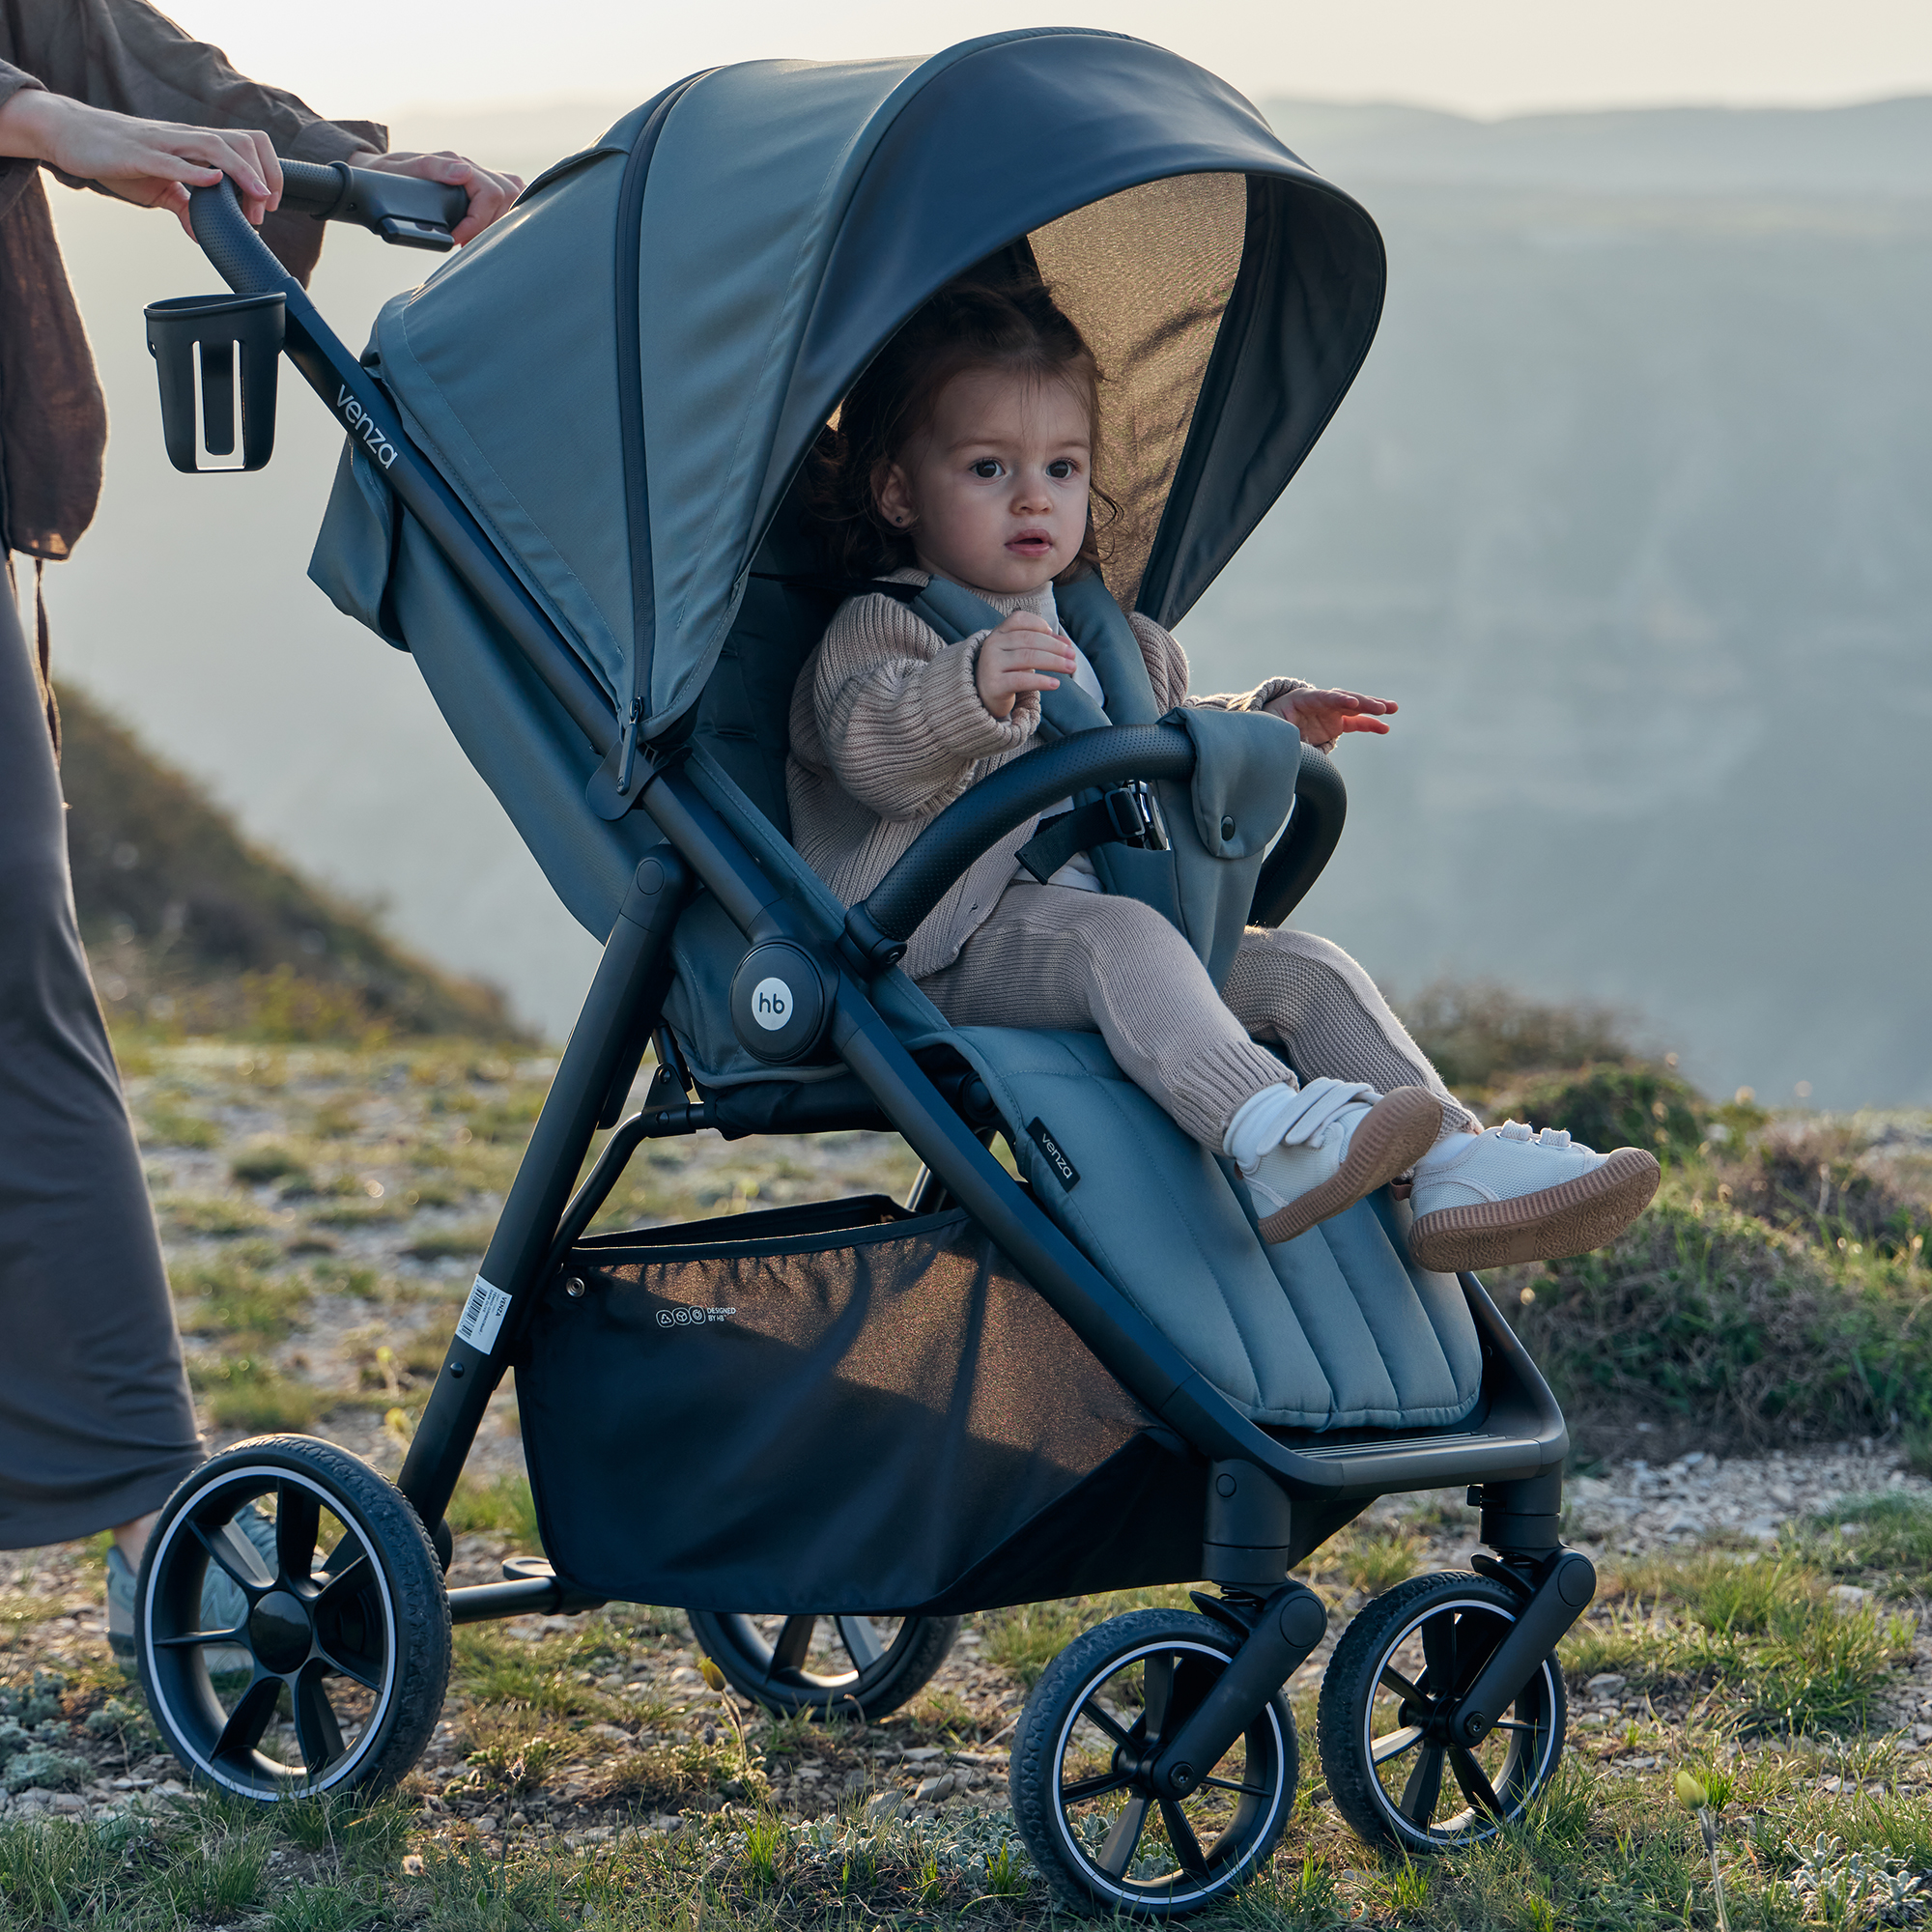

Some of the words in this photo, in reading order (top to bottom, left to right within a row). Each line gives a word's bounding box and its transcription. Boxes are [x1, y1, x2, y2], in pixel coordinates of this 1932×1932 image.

[336, 384, 398, 469] venza
[758, 991, 785, 1014] hb
[1042, 1133, 1073, 1179] venza
[495, 1296, 508, 1317] VENZA
